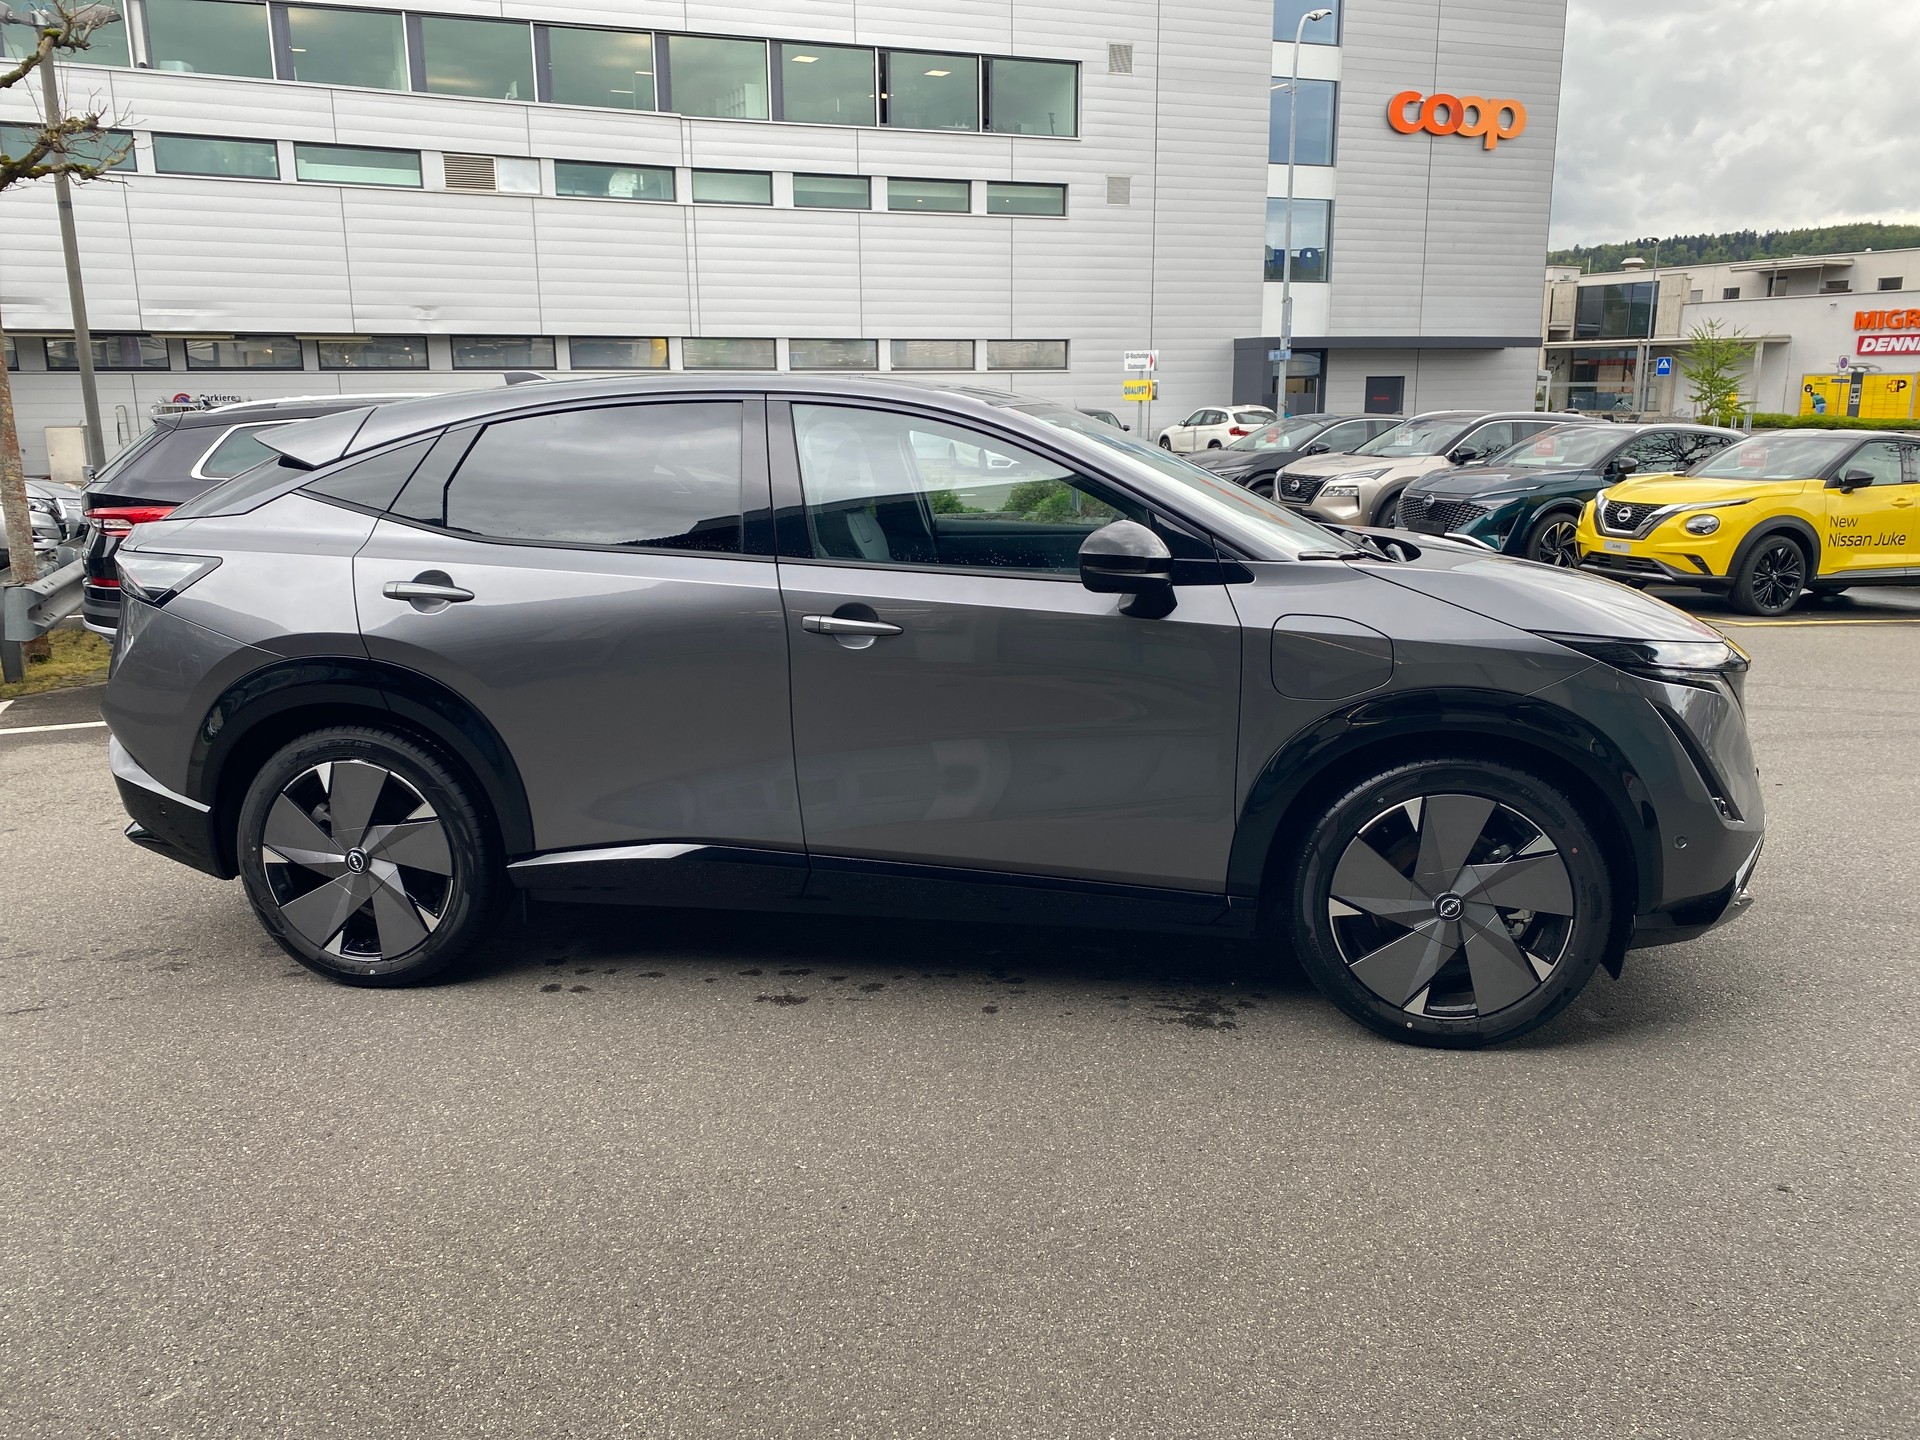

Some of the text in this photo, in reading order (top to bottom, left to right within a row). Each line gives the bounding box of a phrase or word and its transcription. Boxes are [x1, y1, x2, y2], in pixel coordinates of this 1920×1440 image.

[1388, 91, 1527, 150] coop
[1861, 337, 1920, 353] DENN
[1123, 385, 1147, 395] QUALIPET
[1830, 515, 1858, 528] New
[1828, 531, 1906, 547] Nissan Juke
